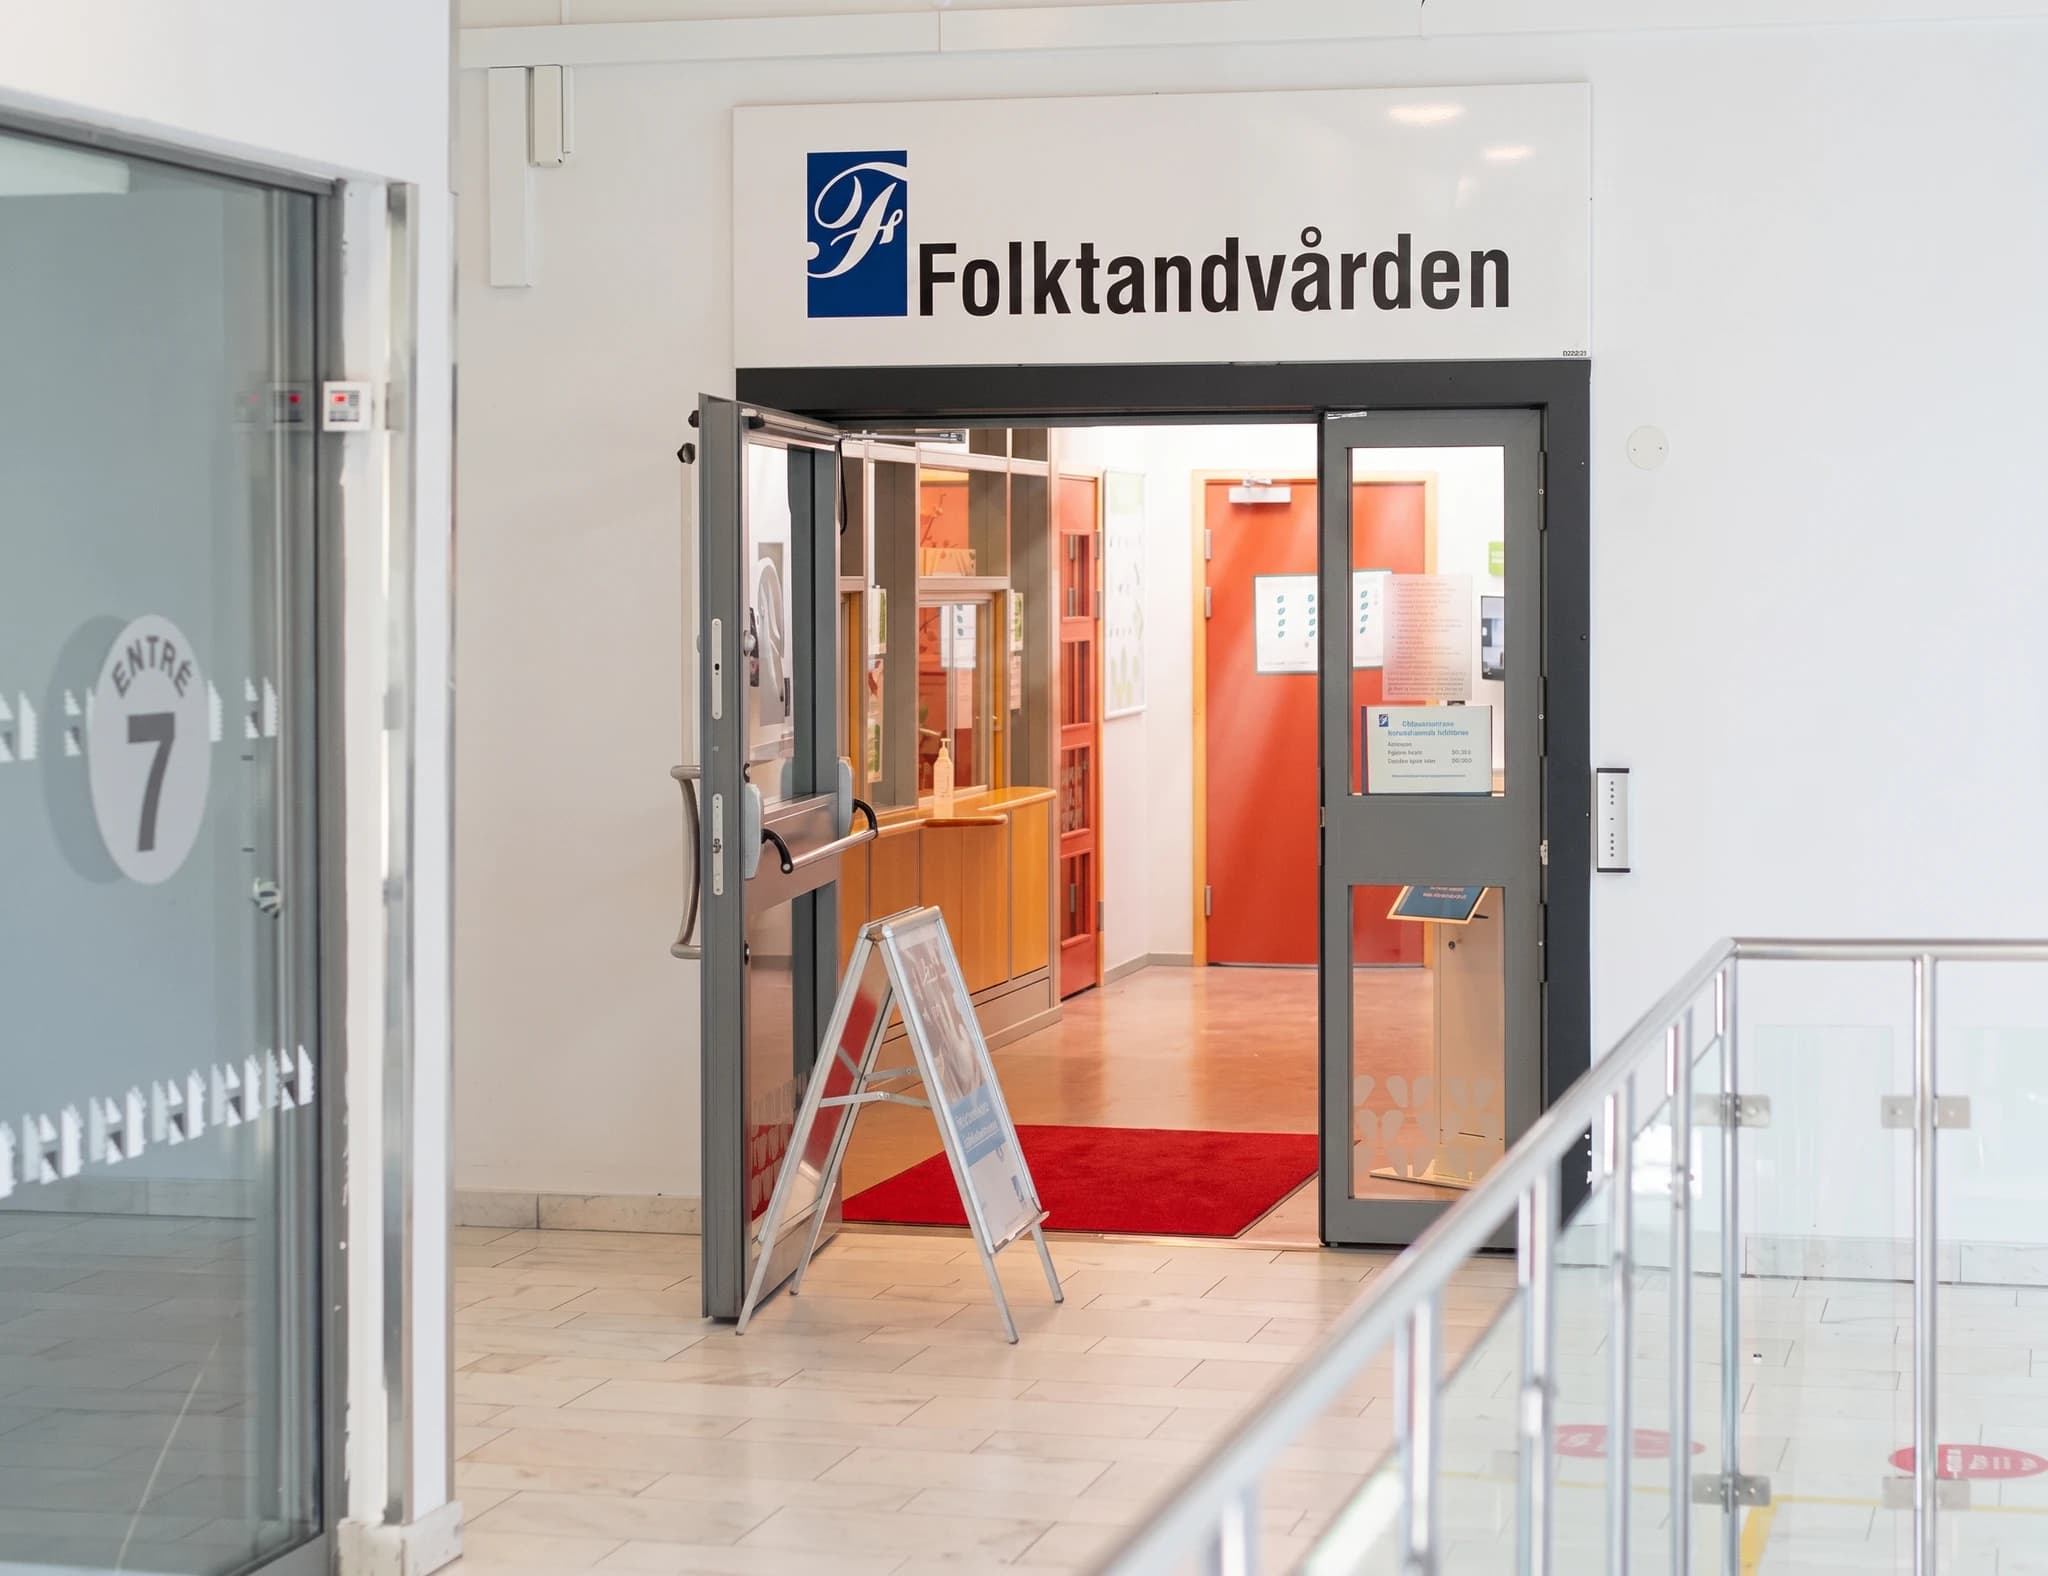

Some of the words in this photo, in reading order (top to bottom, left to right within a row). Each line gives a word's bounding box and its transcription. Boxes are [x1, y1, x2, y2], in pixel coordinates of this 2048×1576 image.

[920, 227, 1508, 317] Folktandvården
[112, 635, 192, 698] ENTRÉ
[127, 712, 175, 852] 7
